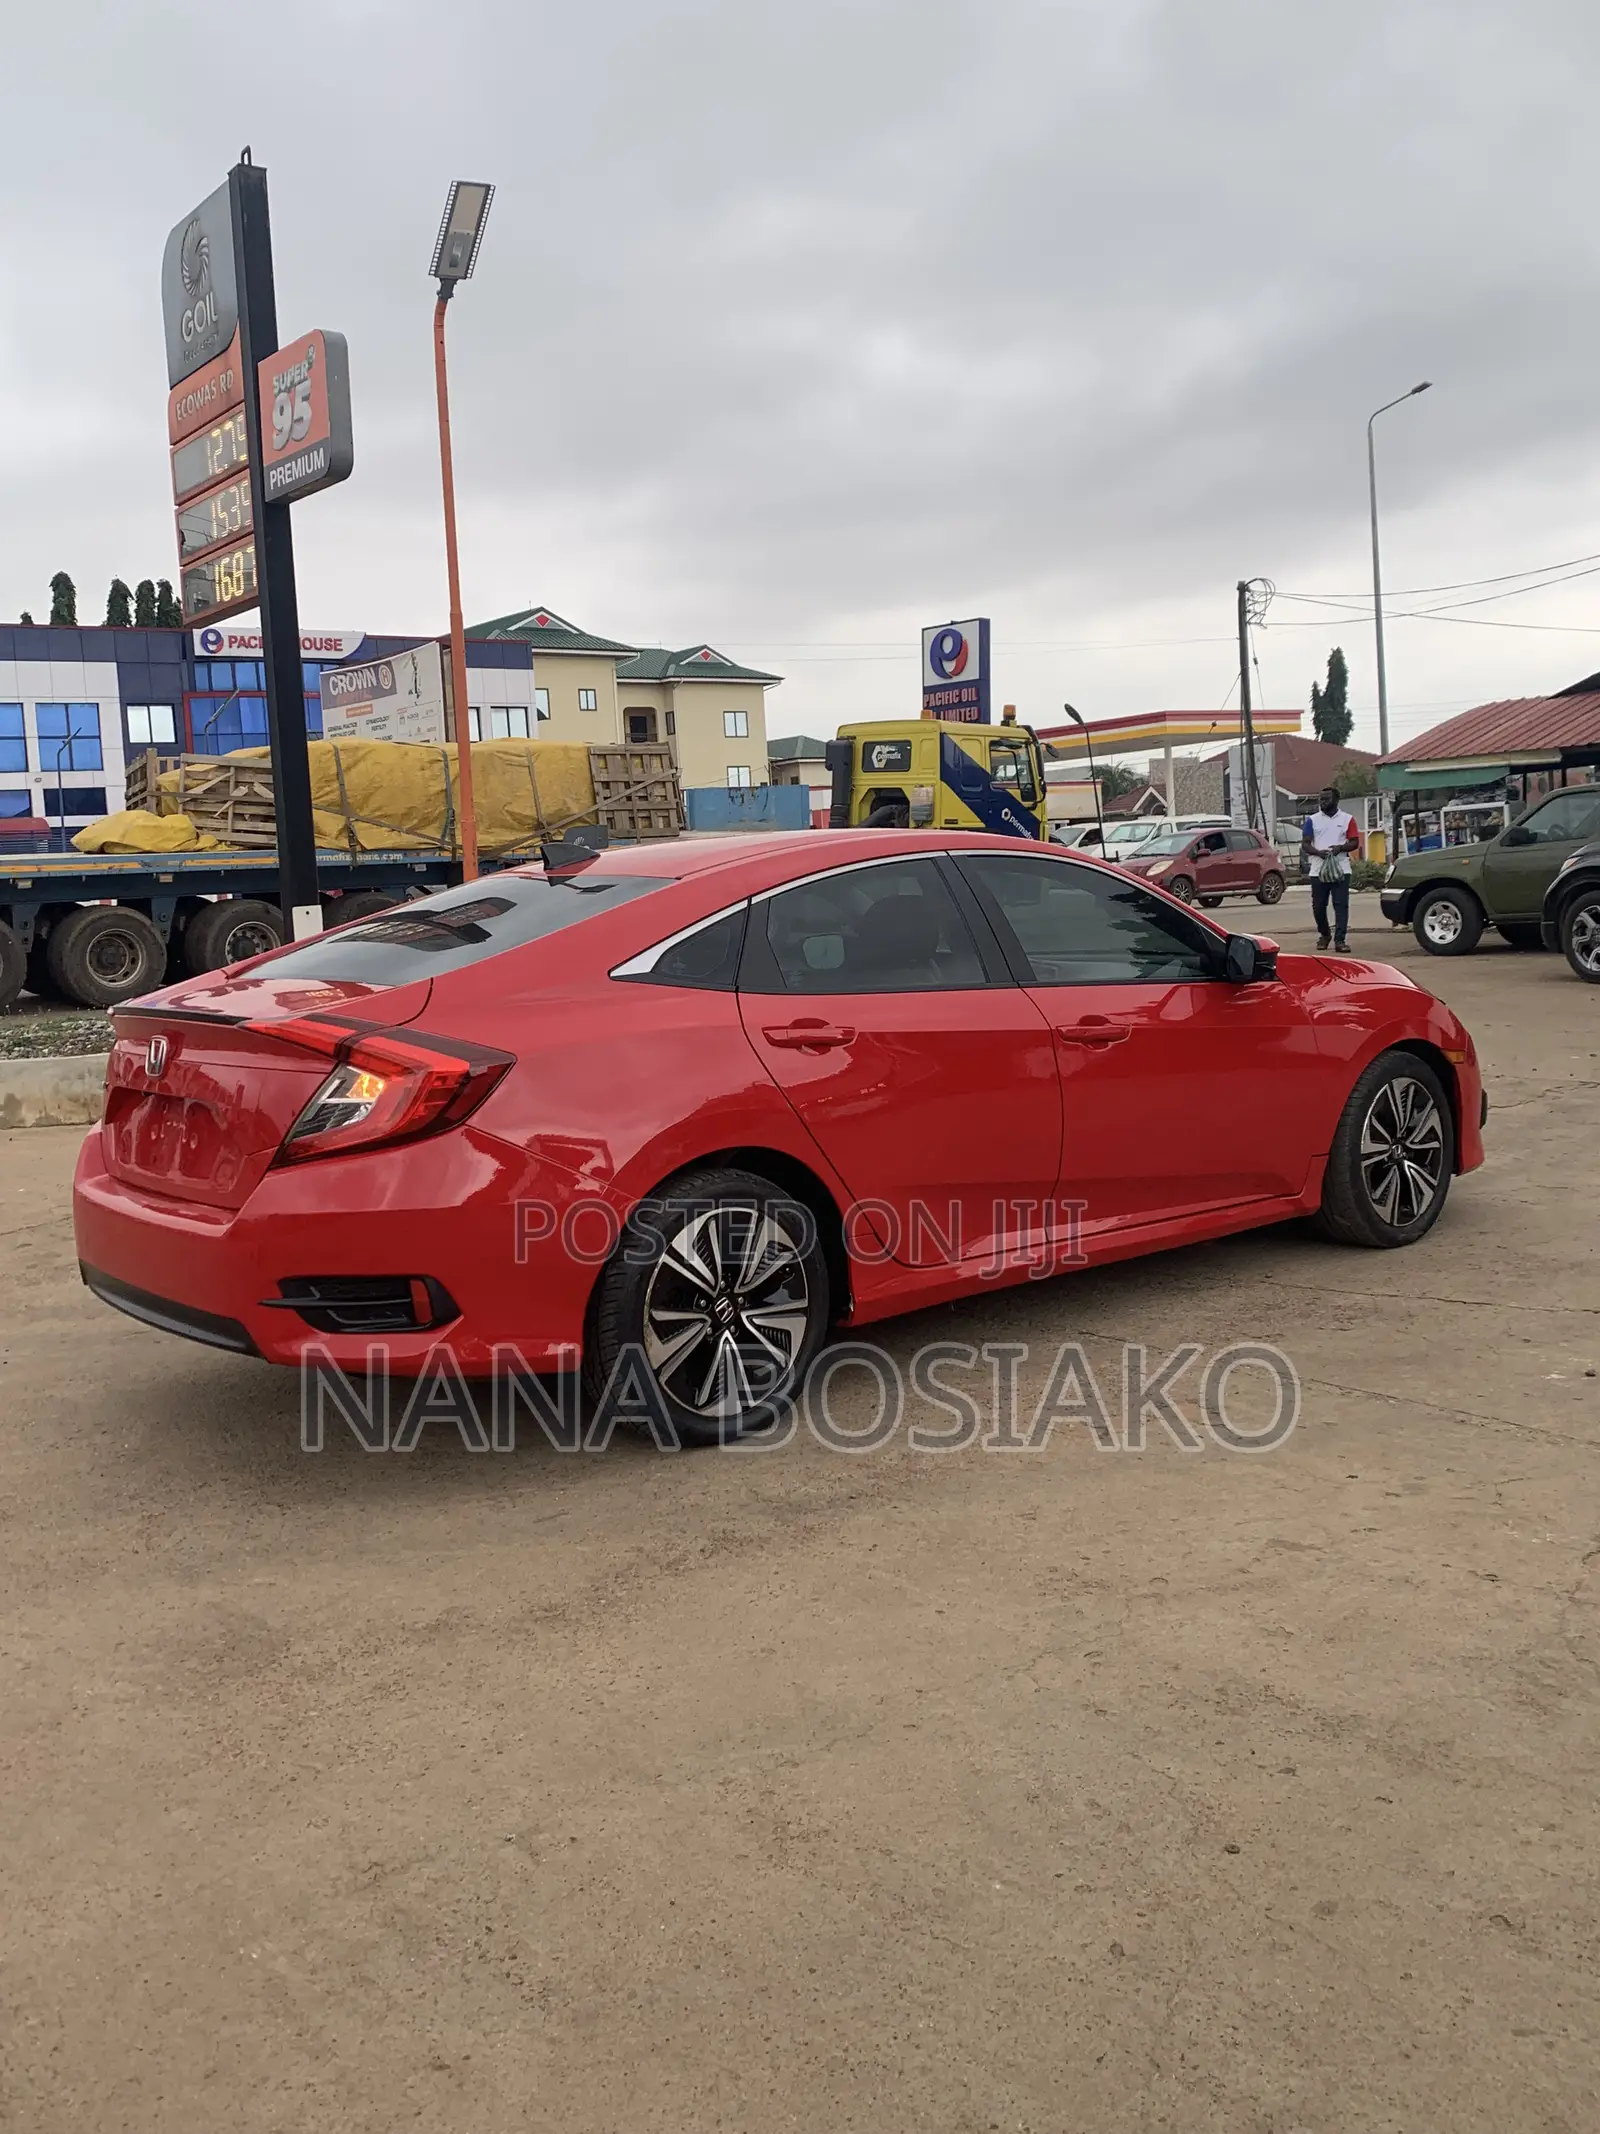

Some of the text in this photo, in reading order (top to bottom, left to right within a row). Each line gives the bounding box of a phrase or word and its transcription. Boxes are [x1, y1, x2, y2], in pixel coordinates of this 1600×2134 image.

[182, 291, 218, 342] GOIL
[176, 369, 234, 421] ECOWAS RD
[272, 361, 309, 396] SUPER
[272, 378, 312, 451] 95
[269, 447, 325, 490] PREMIUM
[300, 637, 344, 651] OUSE
[329, 667, 377, 696] CROWN
[924, 687, 978, 707] PACIFIC OIL
[941, 706, 979, 722] LIMITED
